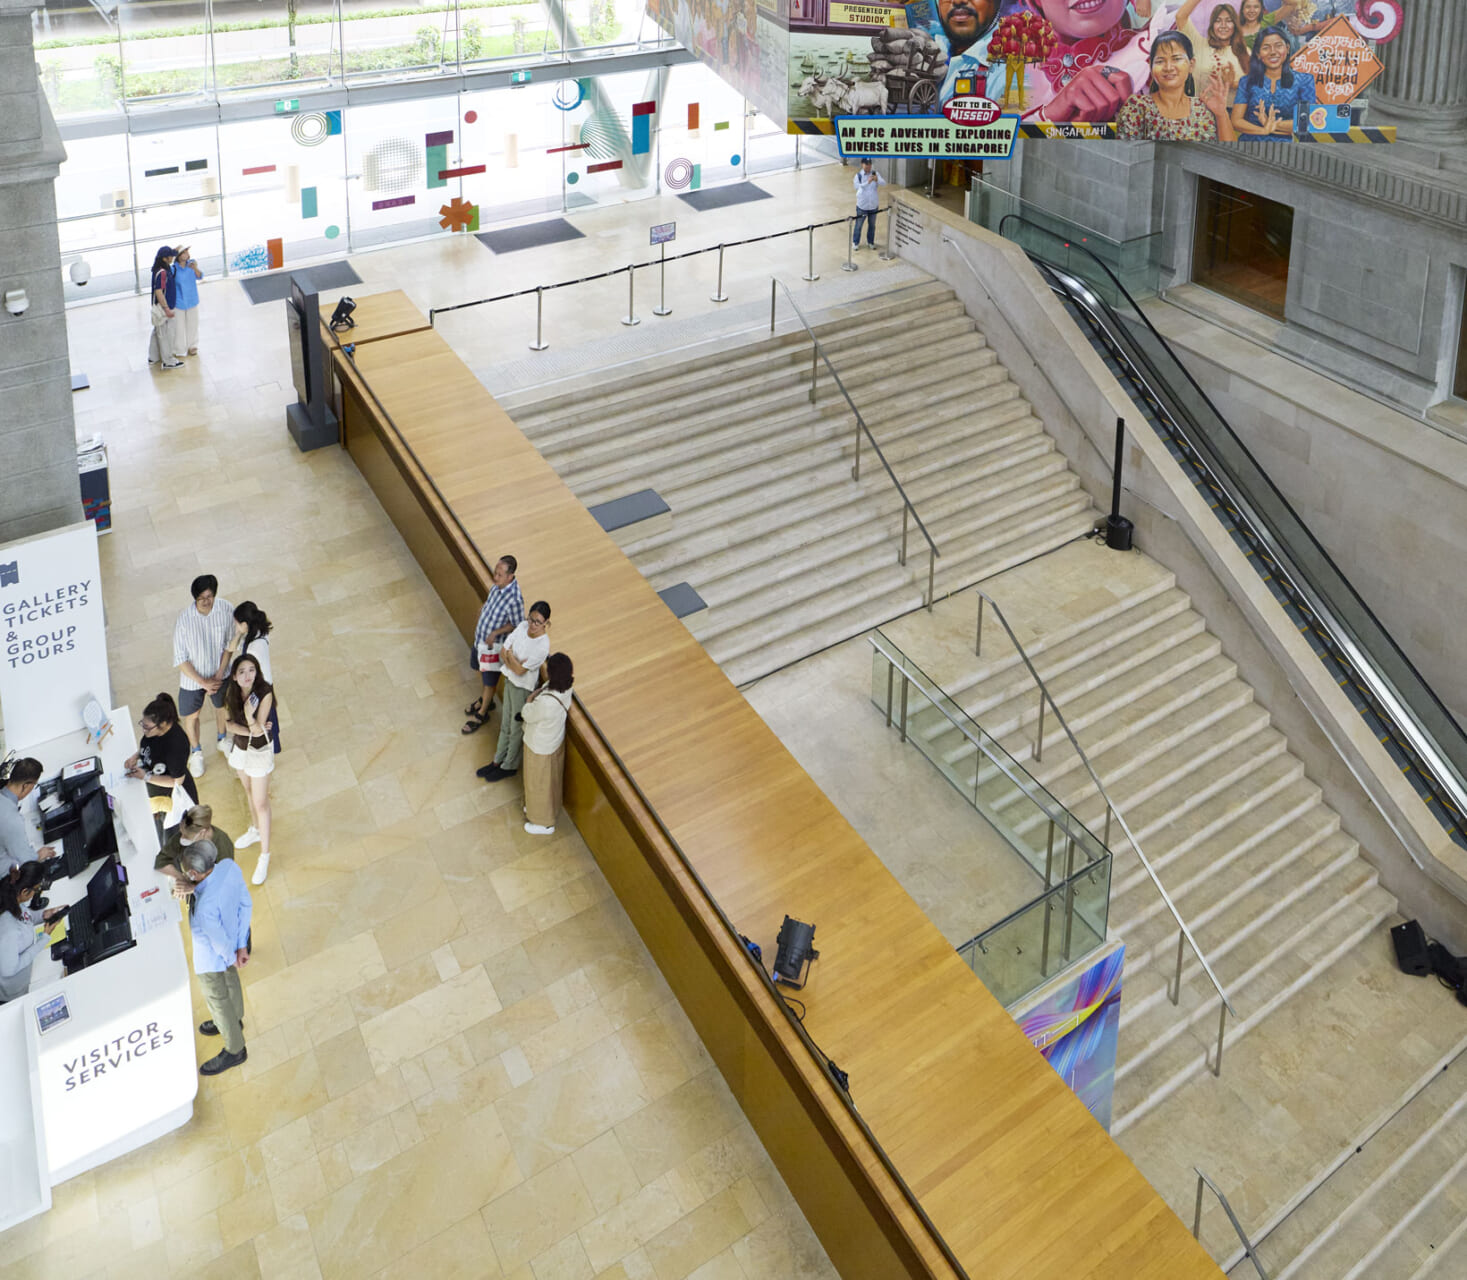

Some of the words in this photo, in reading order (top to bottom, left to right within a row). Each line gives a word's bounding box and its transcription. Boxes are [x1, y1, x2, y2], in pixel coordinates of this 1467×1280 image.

[844, 5, 883, 15] PRESENTED
[883, 7, 892, 15] BY
[952, 100, 968, 108] NOT
[981, 101, 992, 109] BE
[950, 110, 994, 122] MISSED!
[842, 127, 856, 138] AN
[861, 127, 885, 138] EPIC
[890, 128, 950, 139] ADVENTURE
[955, 128, 1012, 140] EXPLORING
[1045, 124, 1107, 139] SINGAPULAH!
[845, 141, 889, 152] DIVERSE
[894, 142, 923, 153] LIVES
[928, 142, 940, 153] IN
[945, 142, 1008, 154] SINGAPORE!
[2, 579, 92, 615] GALLERY
[4, 594, 89, 629] TICKETS
[6, 631, 19, 643] &
[7, 625, 77, 656] GROUP
[8, 639, 76, 669] TOURS
[63, 1020, 160, 1074] VISITOR
[65, 1029, 175, 1092] SERVICES
